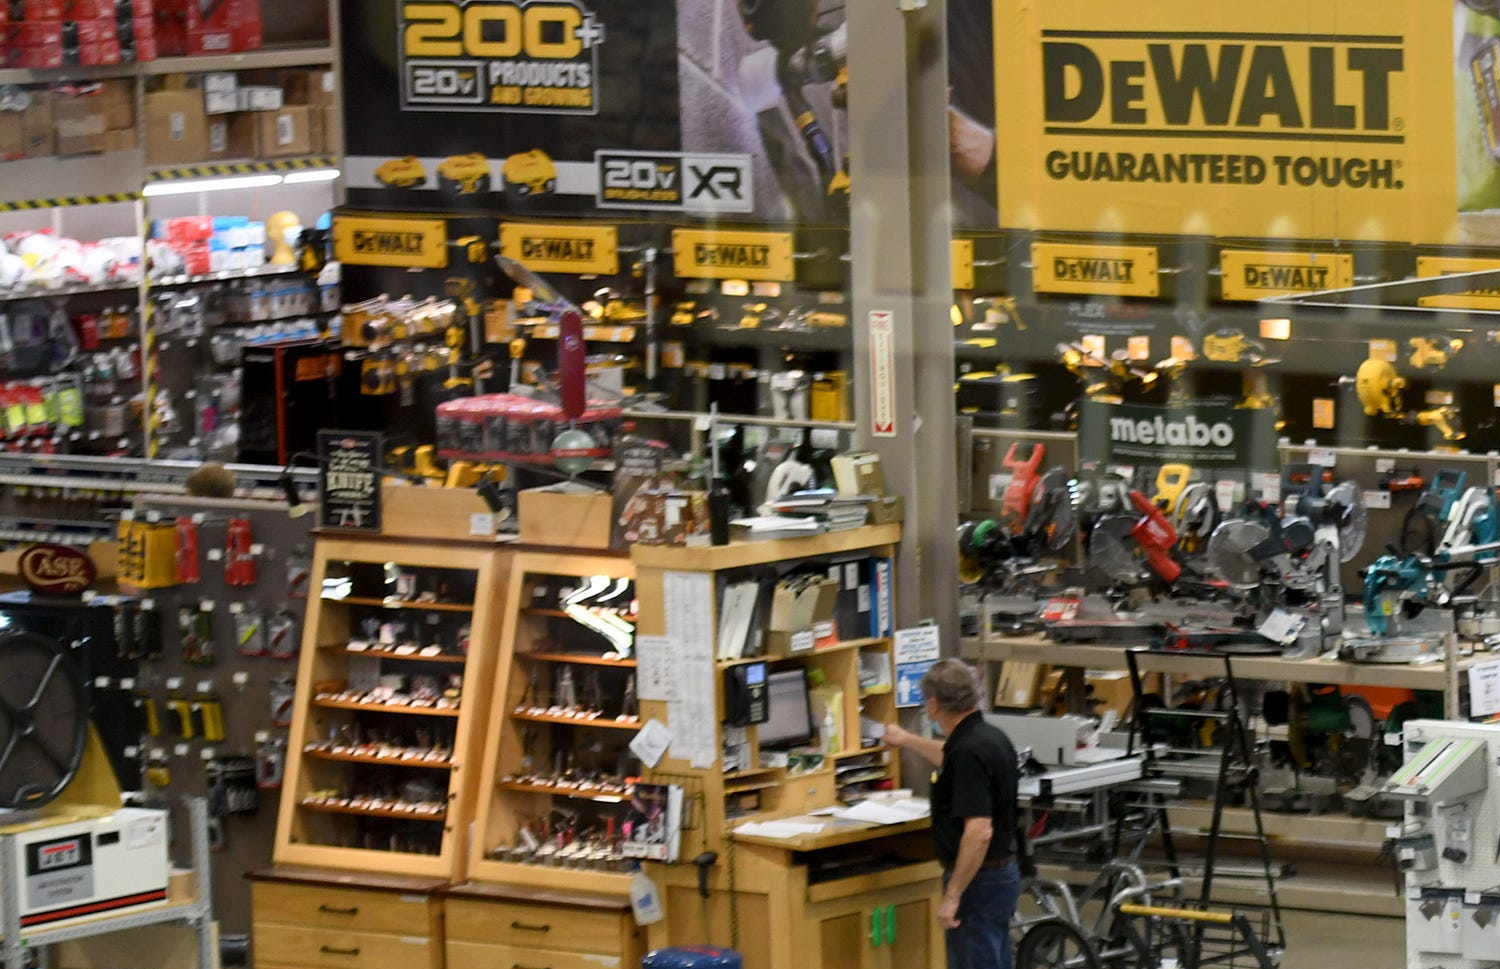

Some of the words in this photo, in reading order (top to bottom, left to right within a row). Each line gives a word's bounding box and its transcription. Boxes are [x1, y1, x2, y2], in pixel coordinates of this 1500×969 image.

[404, 4, 604, 58] 200+
[490, 61, 591, 89] PRODUCTS
[688, 165, 744, 199] XR
[1046, 149, 1267, 185] GUARANTEED
[1111, 414, 1235, 449] metabo
